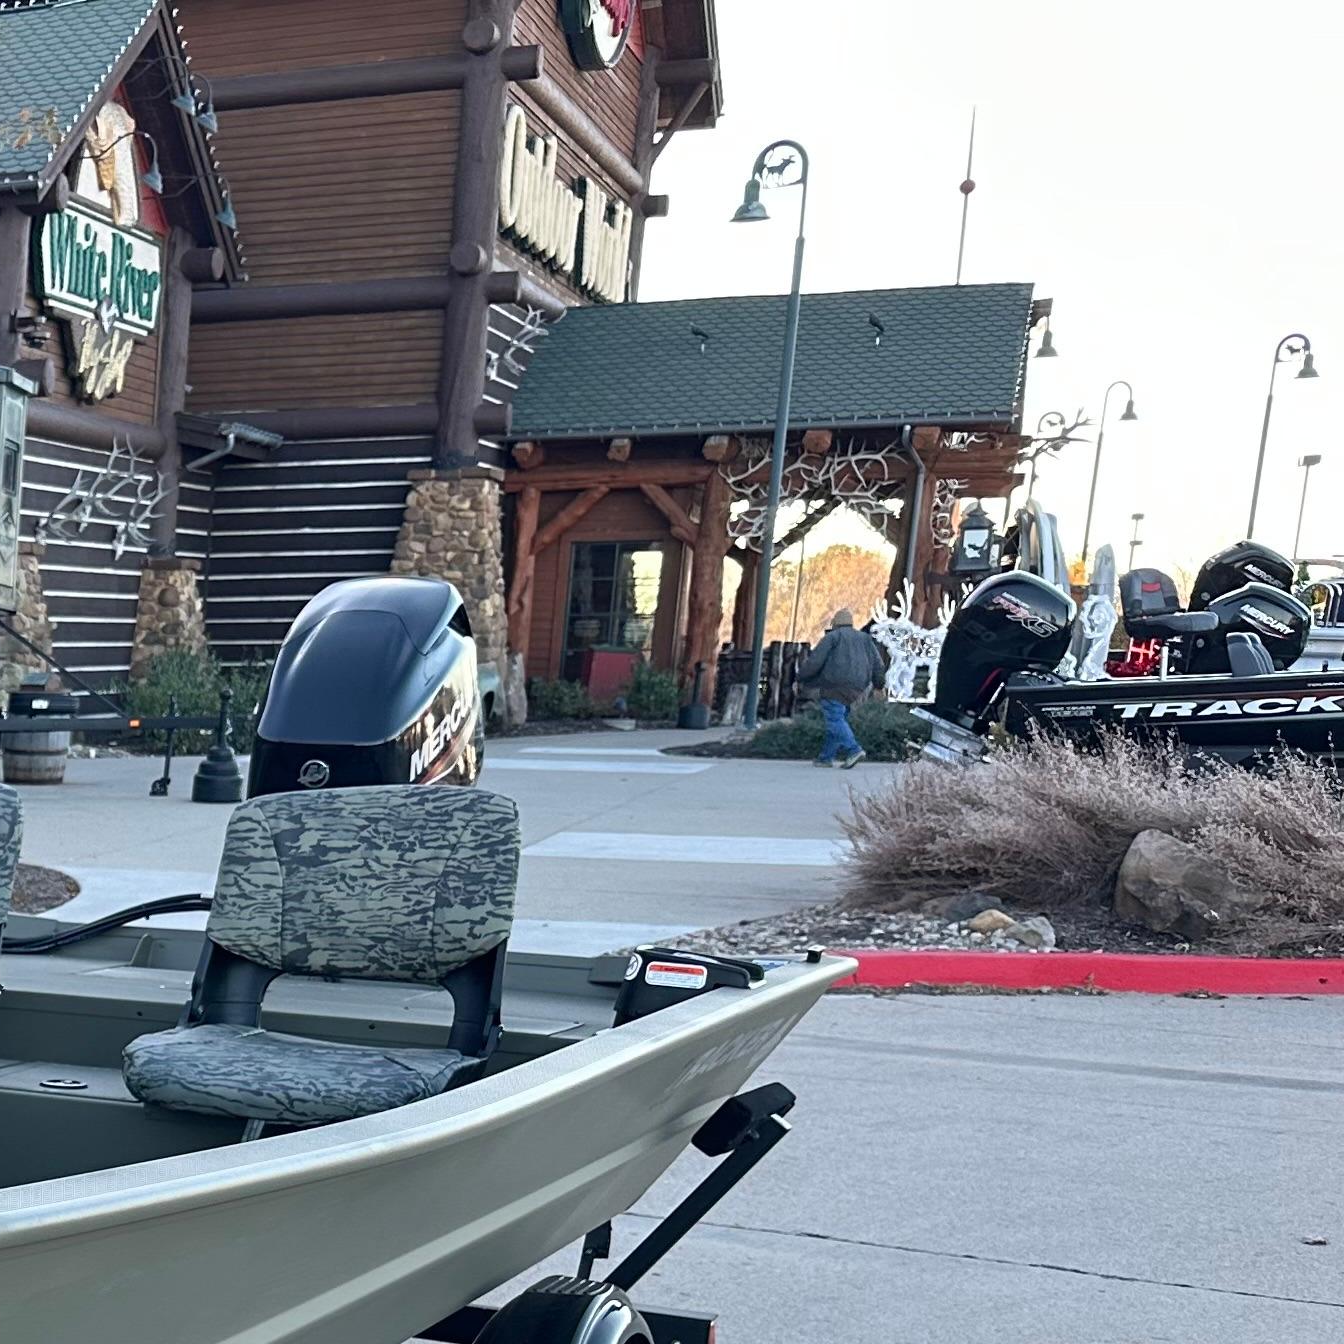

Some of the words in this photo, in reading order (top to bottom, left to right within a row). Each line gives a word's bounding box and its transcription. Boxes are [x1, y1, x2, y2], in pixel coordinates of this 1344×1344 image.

[49, 211, 107, 302] White
[109, 232, 159, 322] River
[1113, 695, 1344, 719] TRACK
